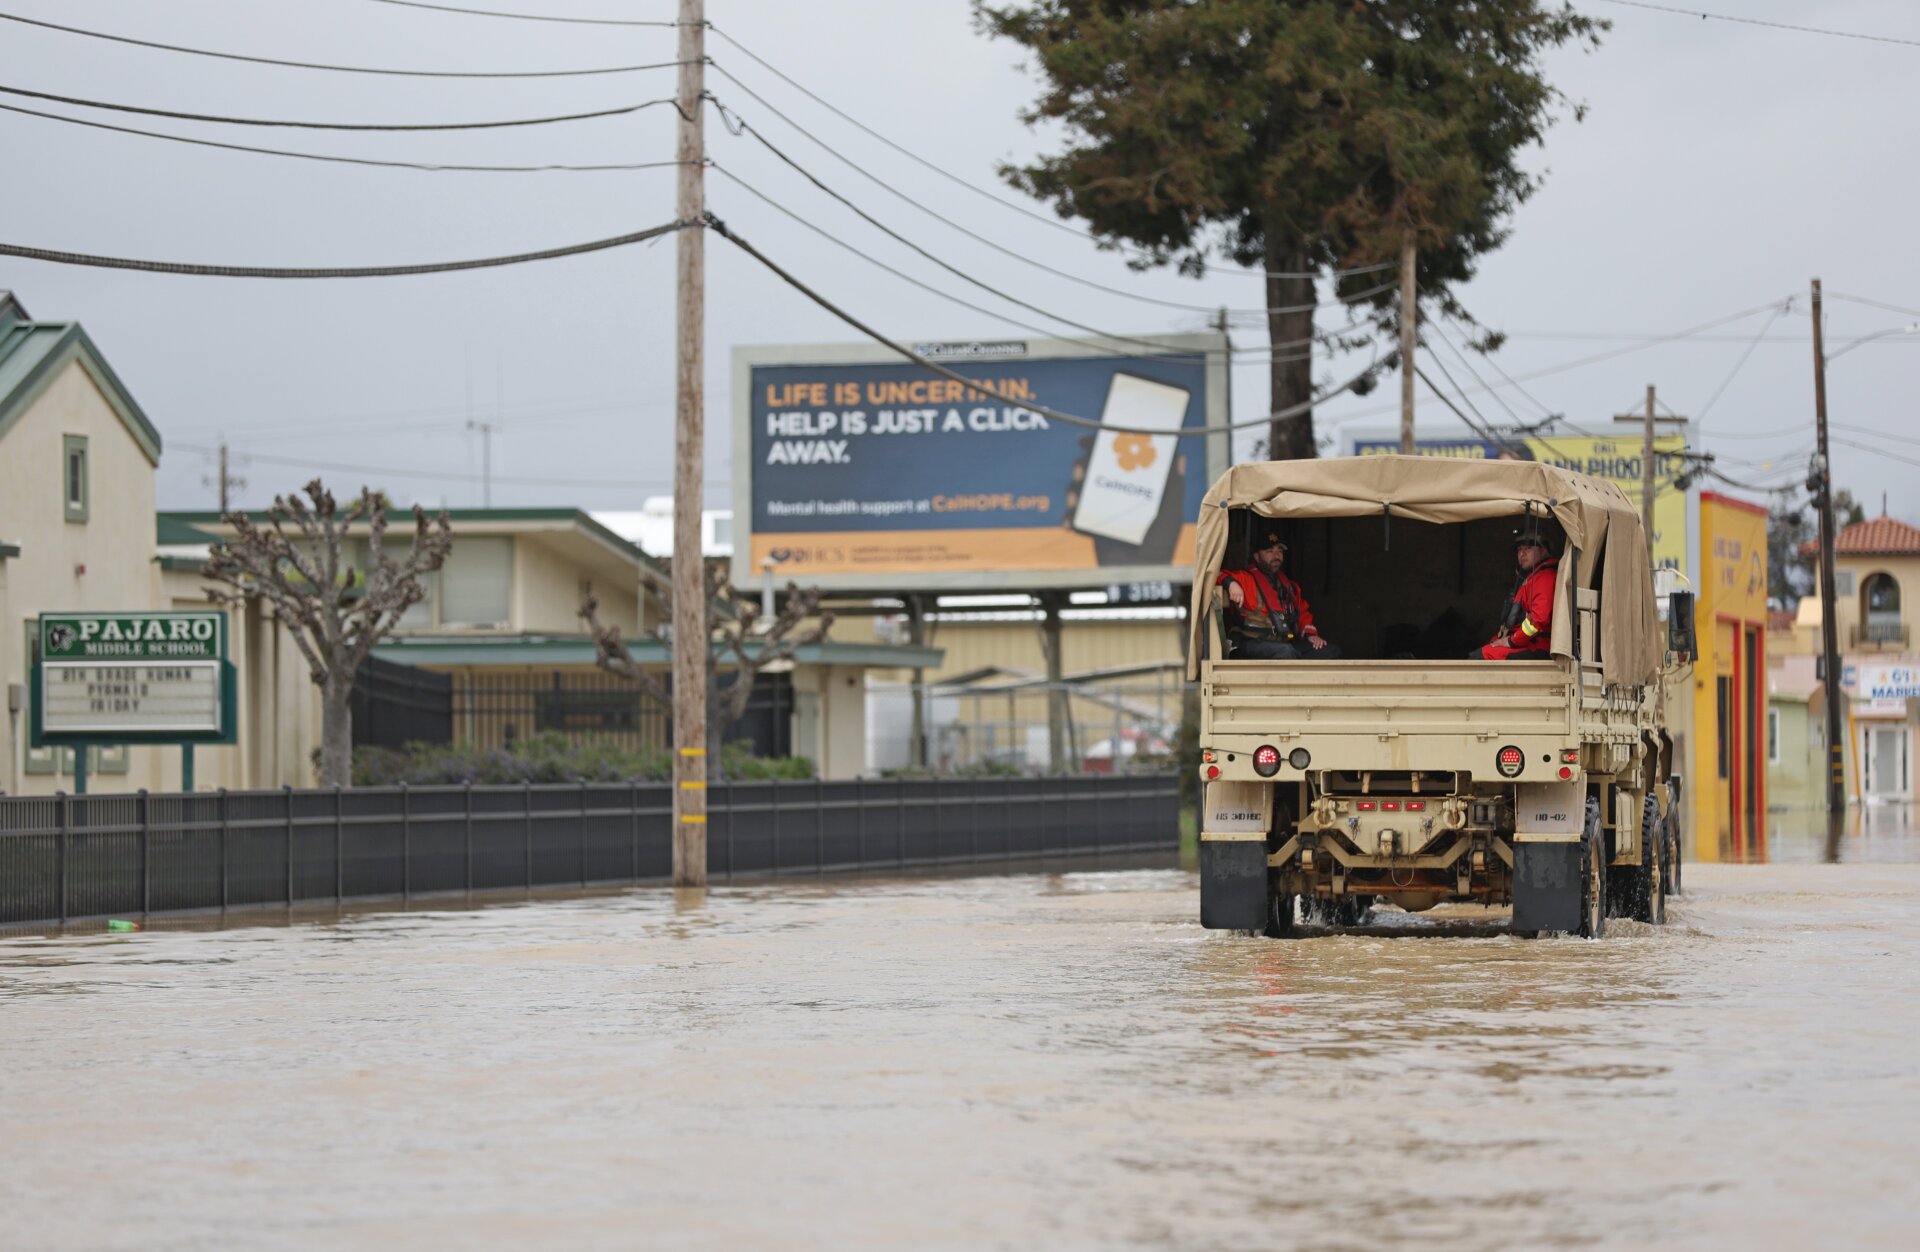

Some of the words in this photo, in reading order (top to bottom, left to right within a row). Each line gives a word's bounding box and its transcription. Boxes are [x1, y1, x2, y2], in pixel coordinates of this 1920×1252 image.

[766, 384, 828, 407] LIFE
[835, 383, 860, 405] IS
[867, 378, 1037, 405] UNCERTAIN.
[766, 412, 836, 436] HELP
[842, 411, 866, 434] IS
[871, 409, 938, 434] JUST
[942, 409, 964, 432] A
[968, 407, 1050, 431] CLICK
[766, 440, 850, 465] AWAY.
[1095, 474, 1154, 499] CalHOPE
[767, 500, 813, 516] Mental
[816, 499, 856, 515] health
[860, 498, 911, 517] support
[913, 499, 930, 514] at
[932, 493, 1051, 513] CalHOPE.org
[79, 620, 214, 641] PAJARO
[85, 643, 144, 656] MIDDLE
[149, 642, 210, 655] SCHOOL
[96, 668, 138, 681] GRADE
[146, 668, 192, 681] HUMAN
[1872, 686, 1920, 699] MARKE
[90, 699, 140, 713] FRIDAY
